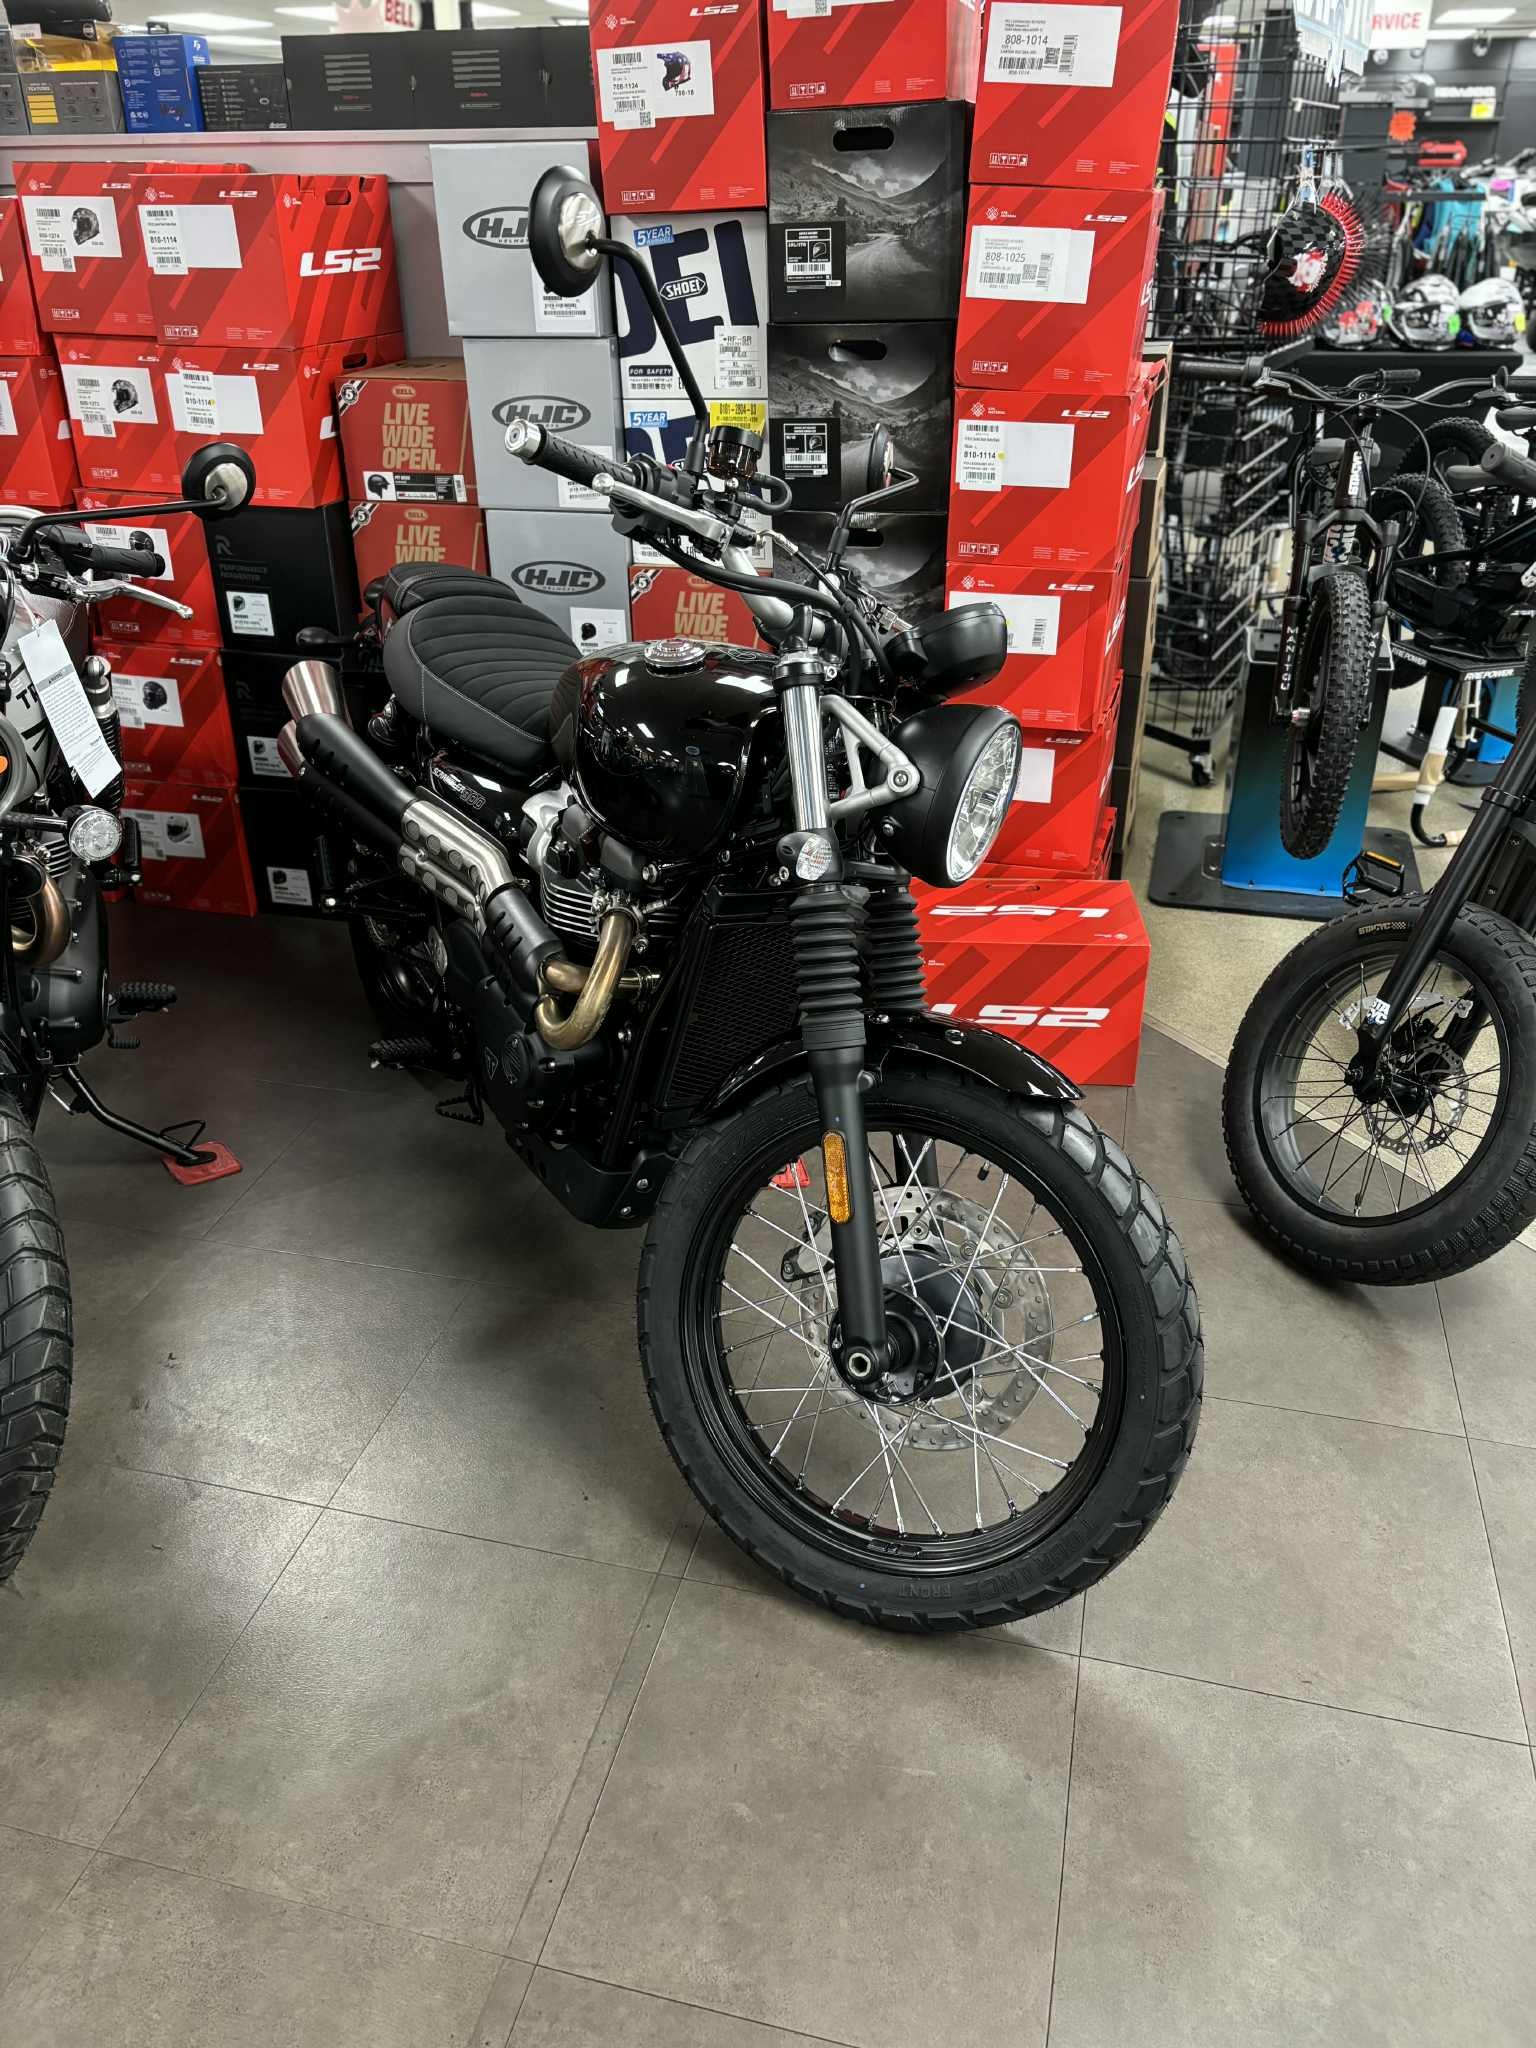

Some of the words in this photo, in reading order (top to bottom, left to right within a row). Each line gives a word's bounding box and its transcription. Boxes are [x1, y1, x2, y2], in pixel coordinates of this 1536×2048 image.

[384, 0, 415, 28] BELL
[690, 4, 739, 16] LS2
[1005, 34, 1048, 45] 808-1014
[218, 190, 258, 198] LS2
[1083, 214, 1128, 223] LS2
[300, 248, 382, 277] LS2
[985, 251, 1026, 263] 808-1025
[666, 279, 701, 298] SHOEI
[242, 363, 279, 371] LS2
[647, 367, 672, 375] SAFETY
[384, 402, 430, 426] LIVE
[1061, 410, 1111, 419] LS2
[382, 425, 435, 448] WIDE
[382, 447, 442, 471] OPEN.
[963, 451, 996, 459] 810-1114
[396, 523, 441, 547] LIVE
[524, 568, 593, 588] HJC
[1048, 583, 1095, 591] LS2
[676, 591, 726, 613] LIVE
[674, 613, 729, 635] WIDE
[1280, 626, 1299, 691] MANITOU
[1046, 736, 1083, 745] LS2
